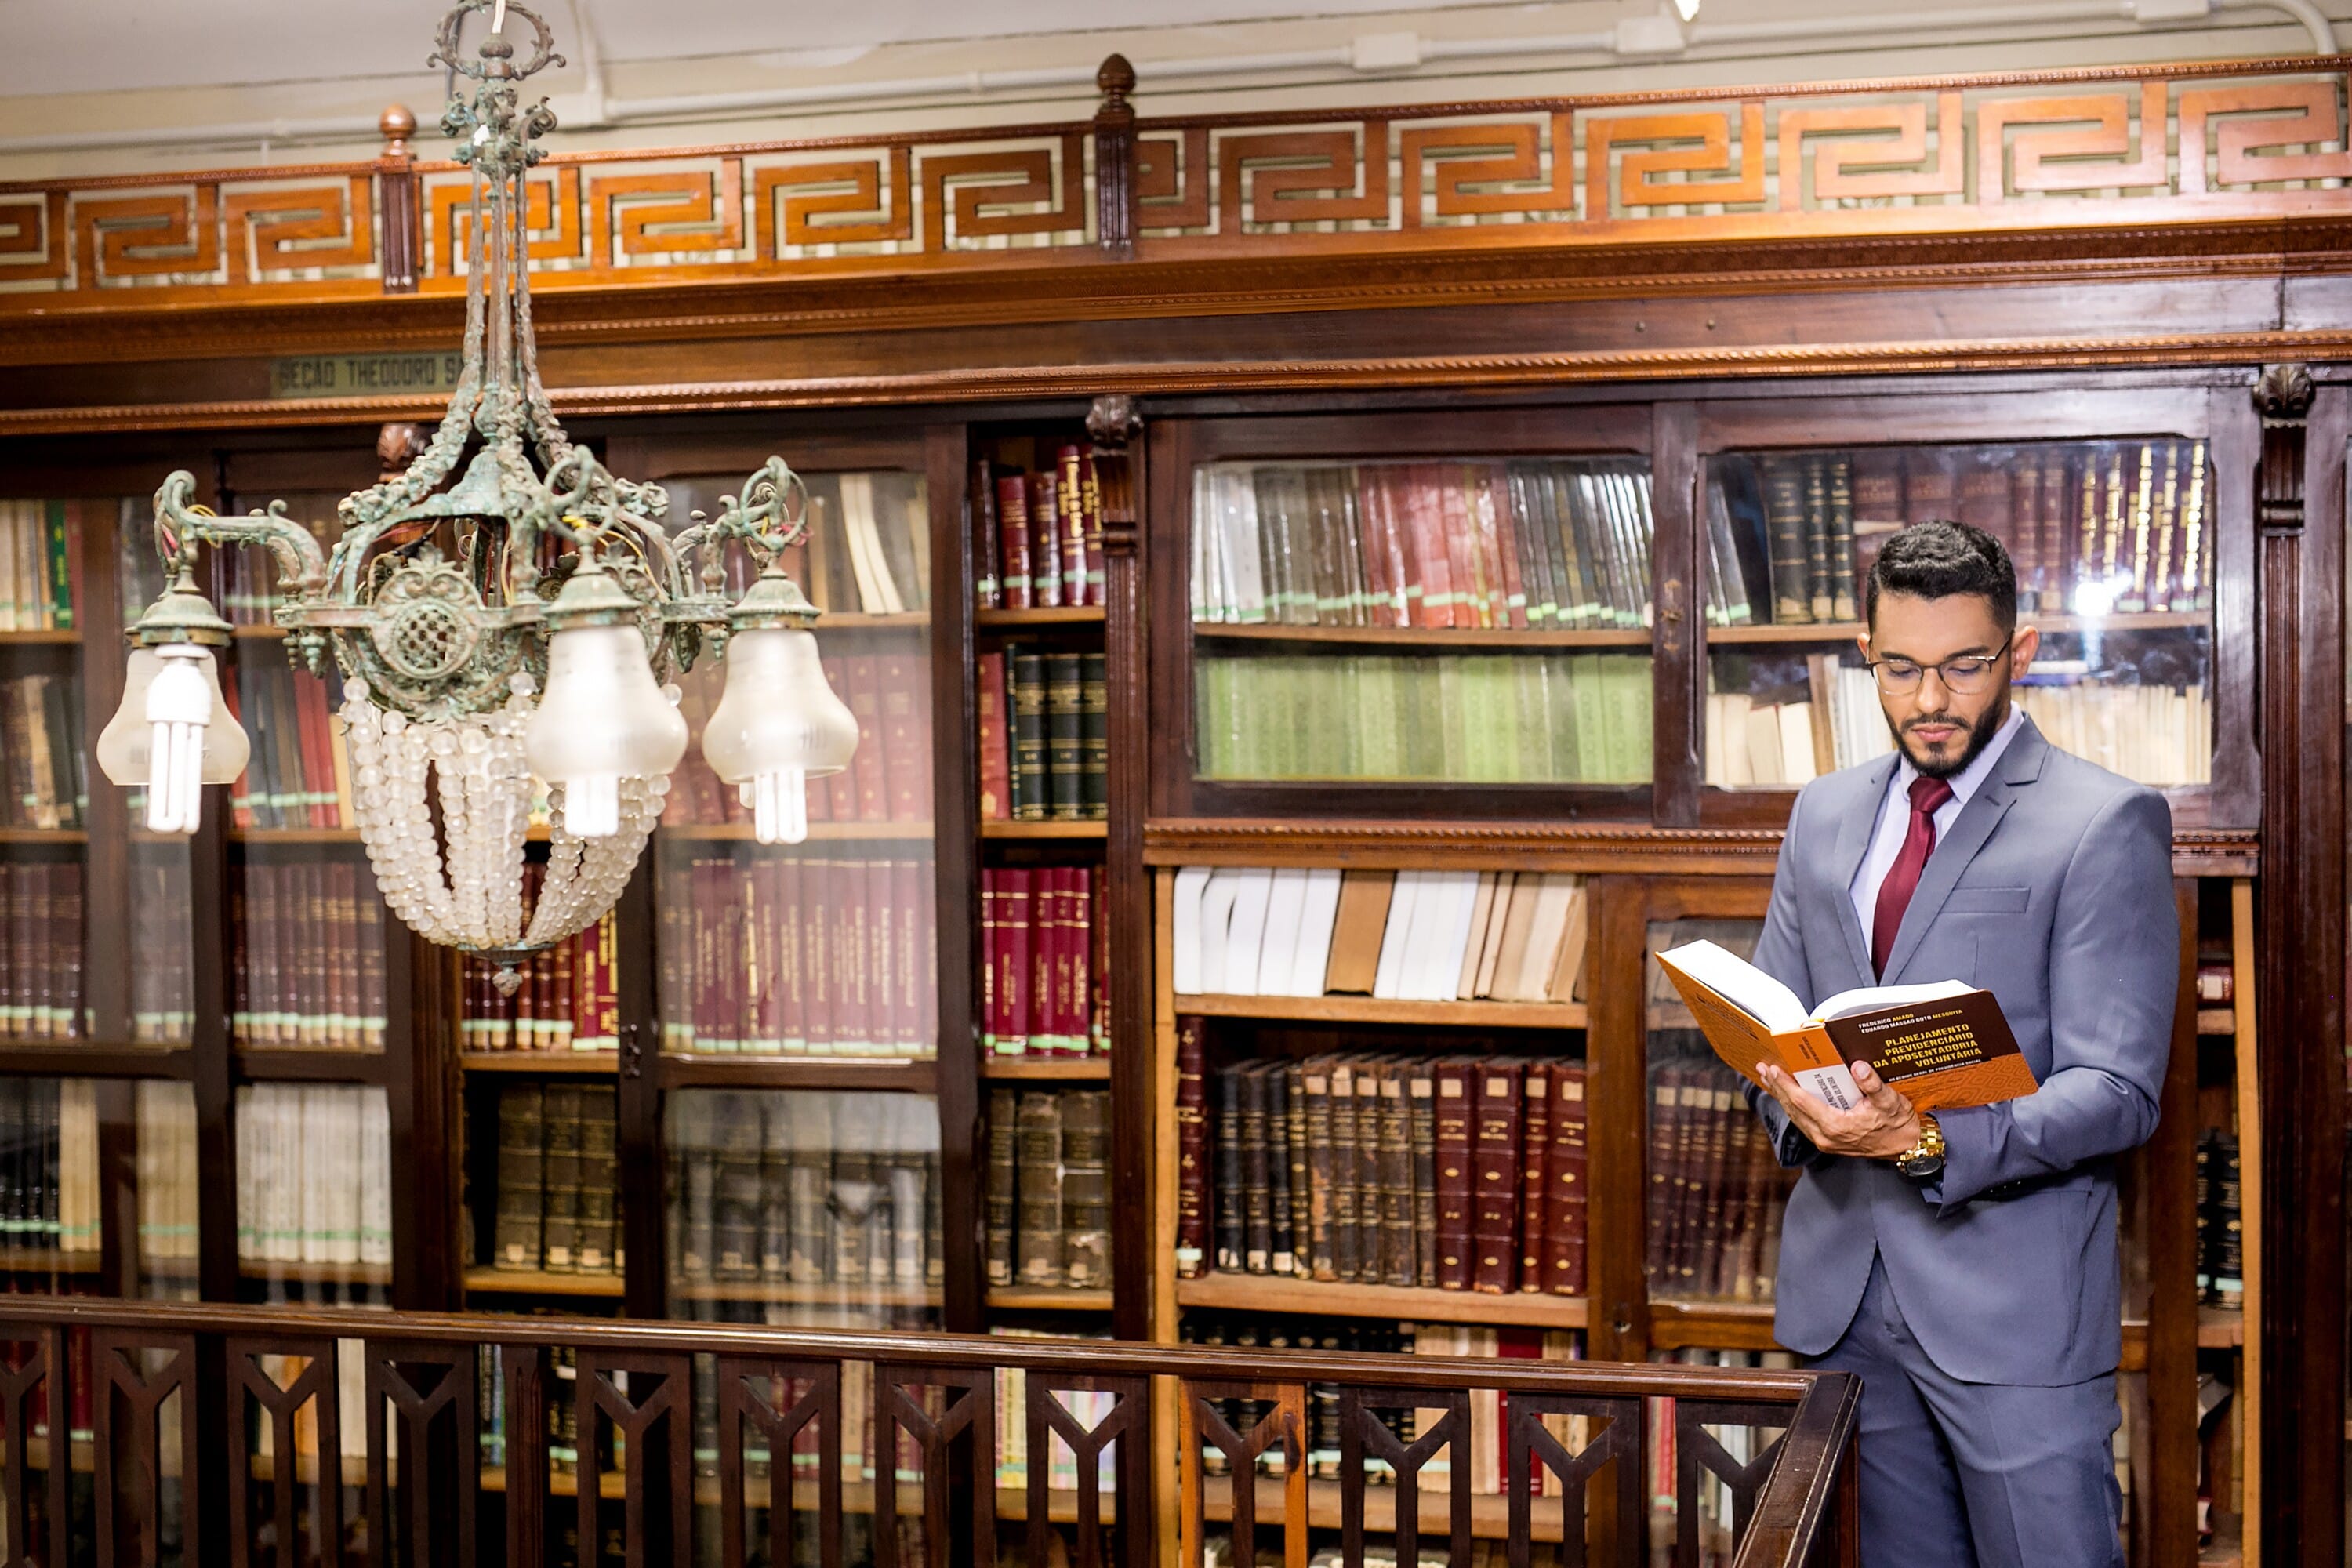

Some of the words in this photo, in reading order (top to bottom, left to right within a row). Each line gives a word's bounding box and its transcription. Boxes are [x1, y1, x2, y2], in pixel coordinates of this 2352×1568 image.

[347, 356, 437, 387] THEODORO
[1858, 1018, 1891, 1029] FREDERICO
[1861, 1024, 1889, 1033] EDUARDO
[1932, 1009, 1963, 1019] MESQUITA
[1884, 1031, 1974, 1056] PREVIDENCIÁRIO
[1885, 1023, 1969, 1047] PLANEJAMENTO
[1873, 1058, 1889, 1068] DA
[1891, 1040, 1978, 1065] APOSENTADORIA
[1915, 1047, 1982, 1067] VOLUNTÁRIA
